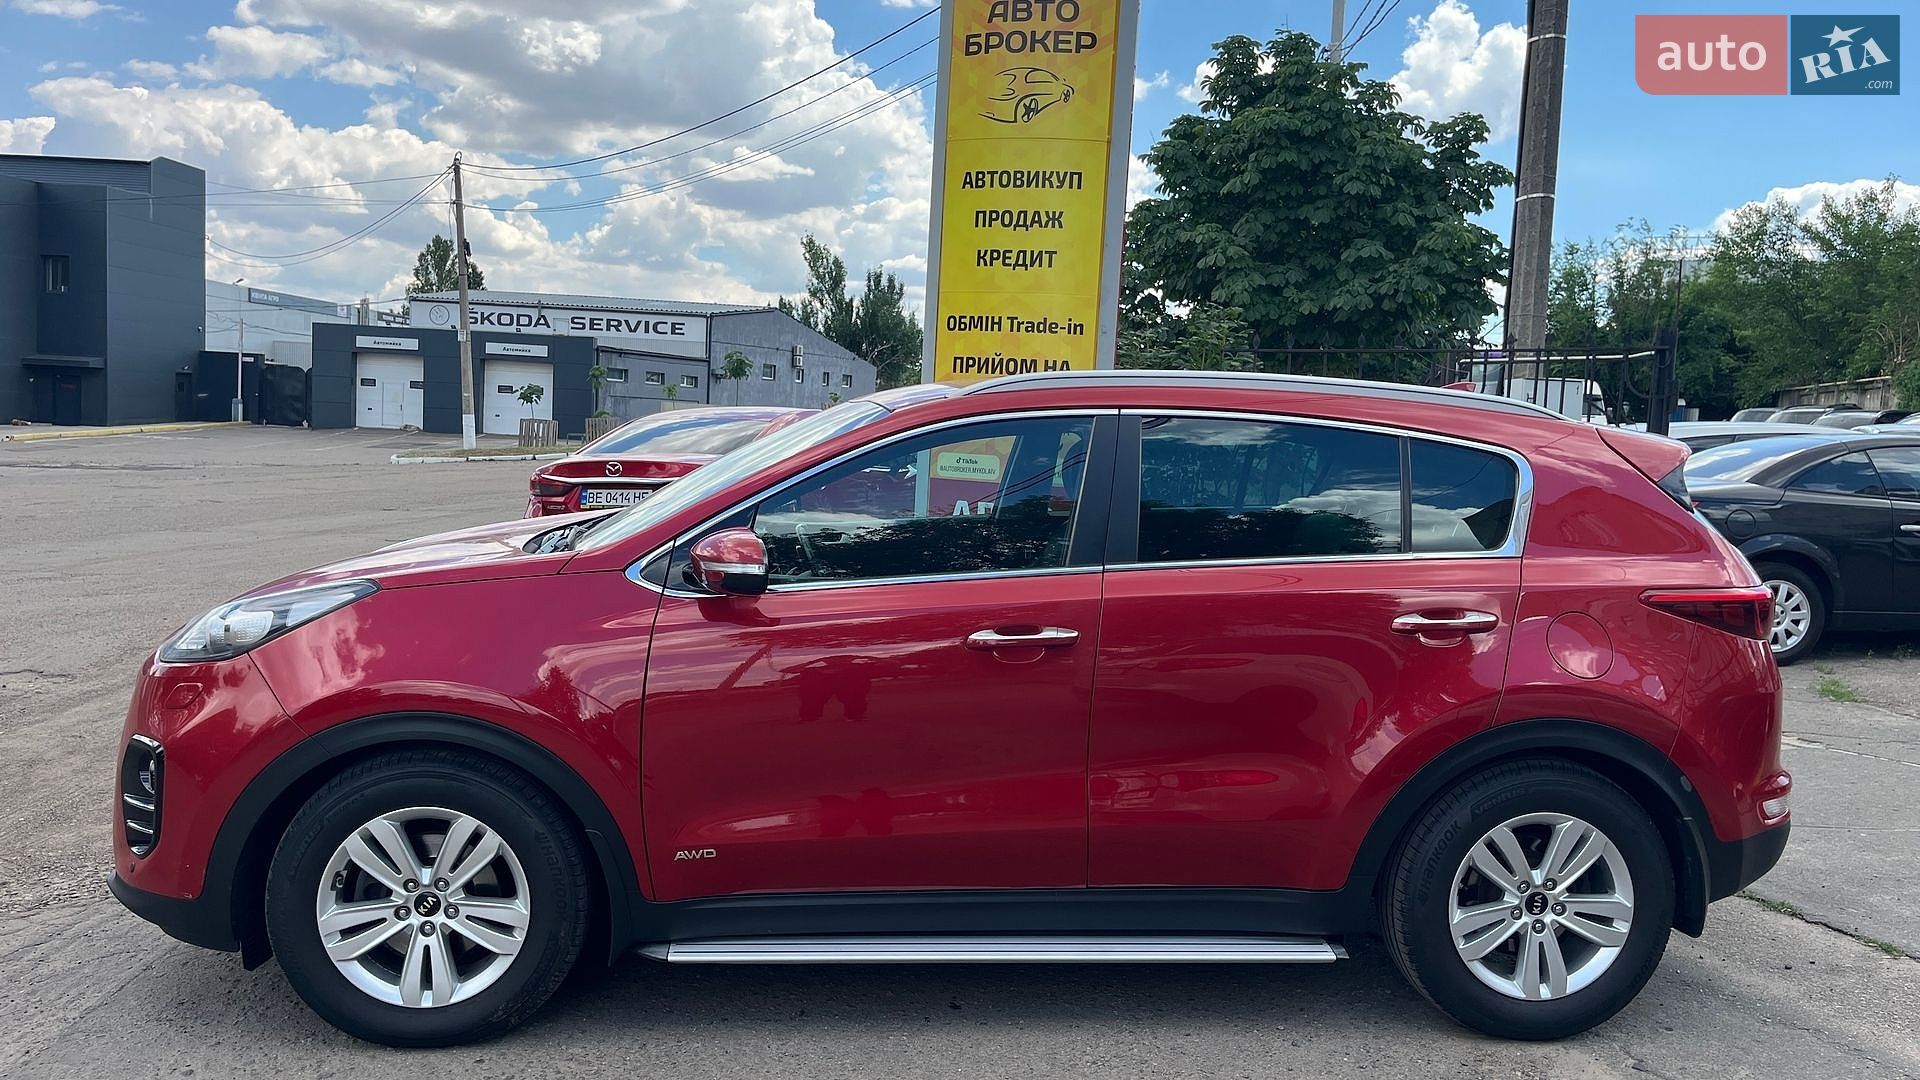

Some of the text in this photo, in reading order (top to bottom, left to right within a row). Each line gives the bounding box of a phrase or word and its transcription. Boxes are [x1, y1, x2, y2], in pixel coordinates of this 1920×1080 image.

[987, 0, 1080, 24] АВТО
[964, 29, 1098, 57] БРОКЕР
[961, 169, 1083, 191] АВТОВИКУП
[974, 209, 1064, 232] ПРОДАЖ
[975, 248, 1058, 271] КРЕДИТ
[468, 306, 686, 336] ŠKODA SERVICE
[946, 315, 1085, 336] ОБМІН Trade-in
[952, 352, 1037, 376] ПРИЙОМ
[588, 492, 603, 503] BE
[605, 492, 631, 504] 0414
[674, 849, 717, 861] AWD
[418, 896, 437, 915] KIA
[1532, 894, 1543, 914] KIA
